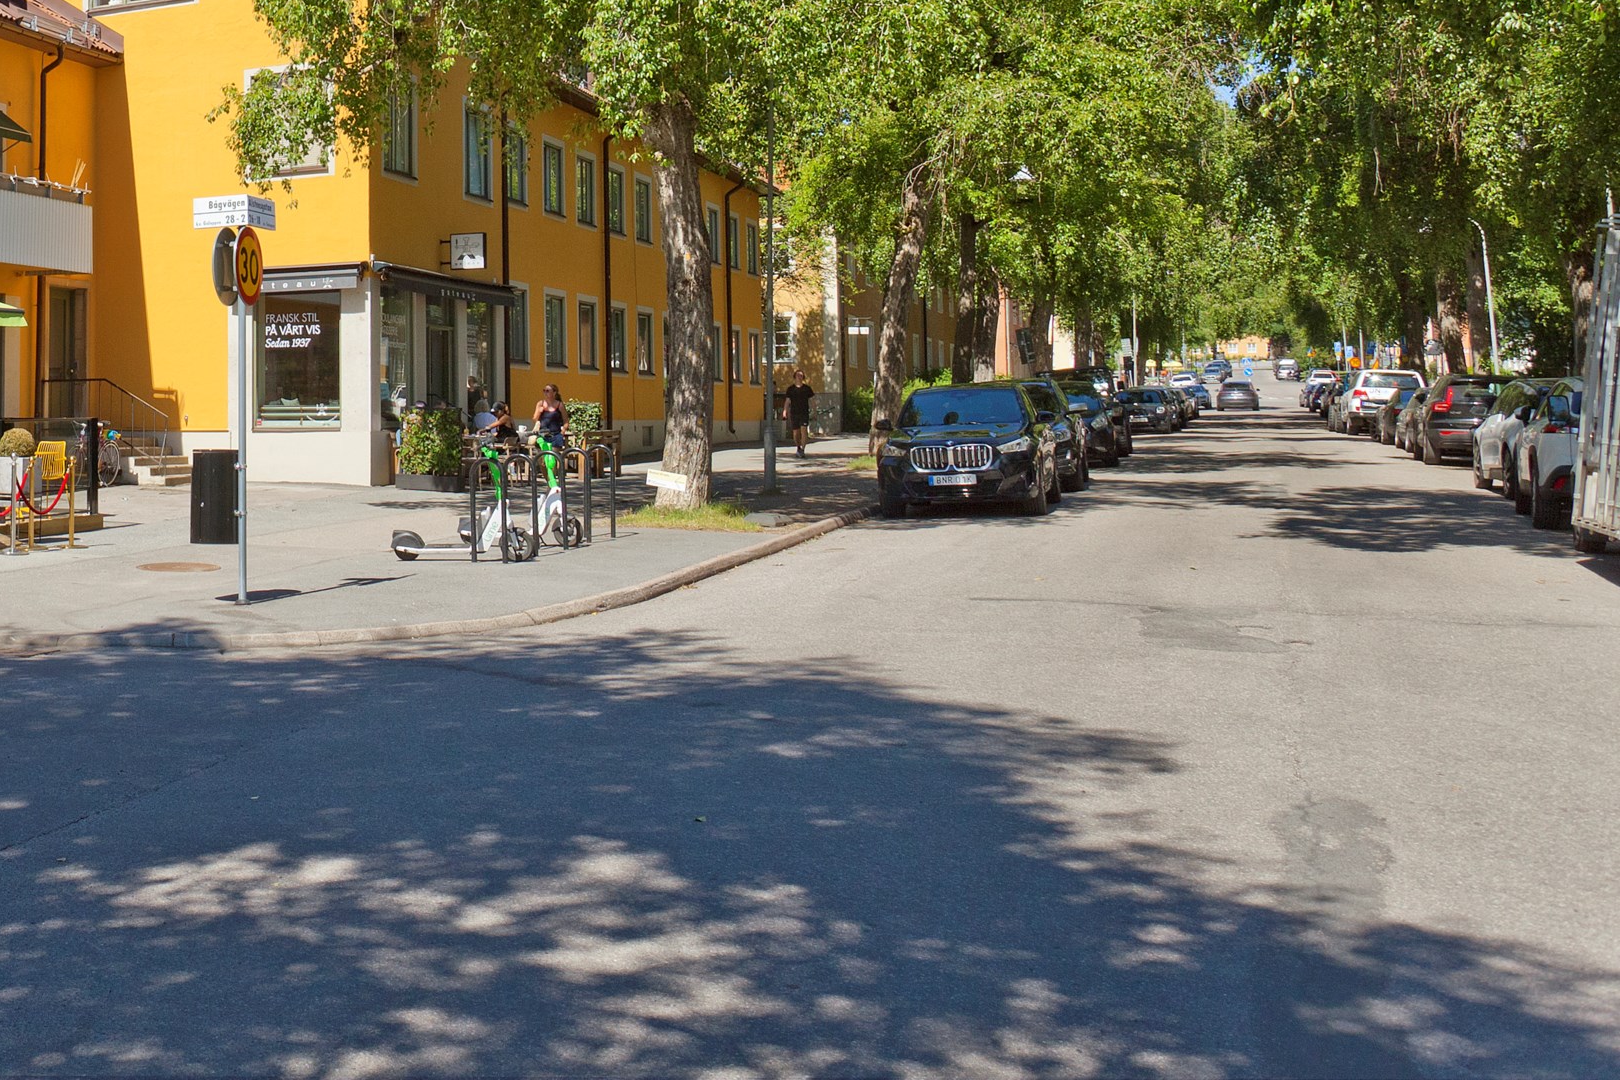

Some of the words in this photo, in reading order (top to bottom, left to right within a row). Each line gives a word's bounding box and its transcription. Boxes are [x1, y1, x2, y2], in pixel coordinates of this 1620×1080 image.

[208, 199, 246, 211] Bågvägen
[240, 246, 259, 285] 30
[261, 281, 316, 290] teau
[265, 313, 300, 323] FRANSK
[302, 312, 320, 322] STIL
[265, 324, 278, 336] PÅ
[279, 323, 304, 335] VÅRT
[306, 324, 321, 335] VIS
[265, 338, 290, 348] Sedan
[291, 338, 311, 348] 1937
[936, 476, 953, 484] BNR
